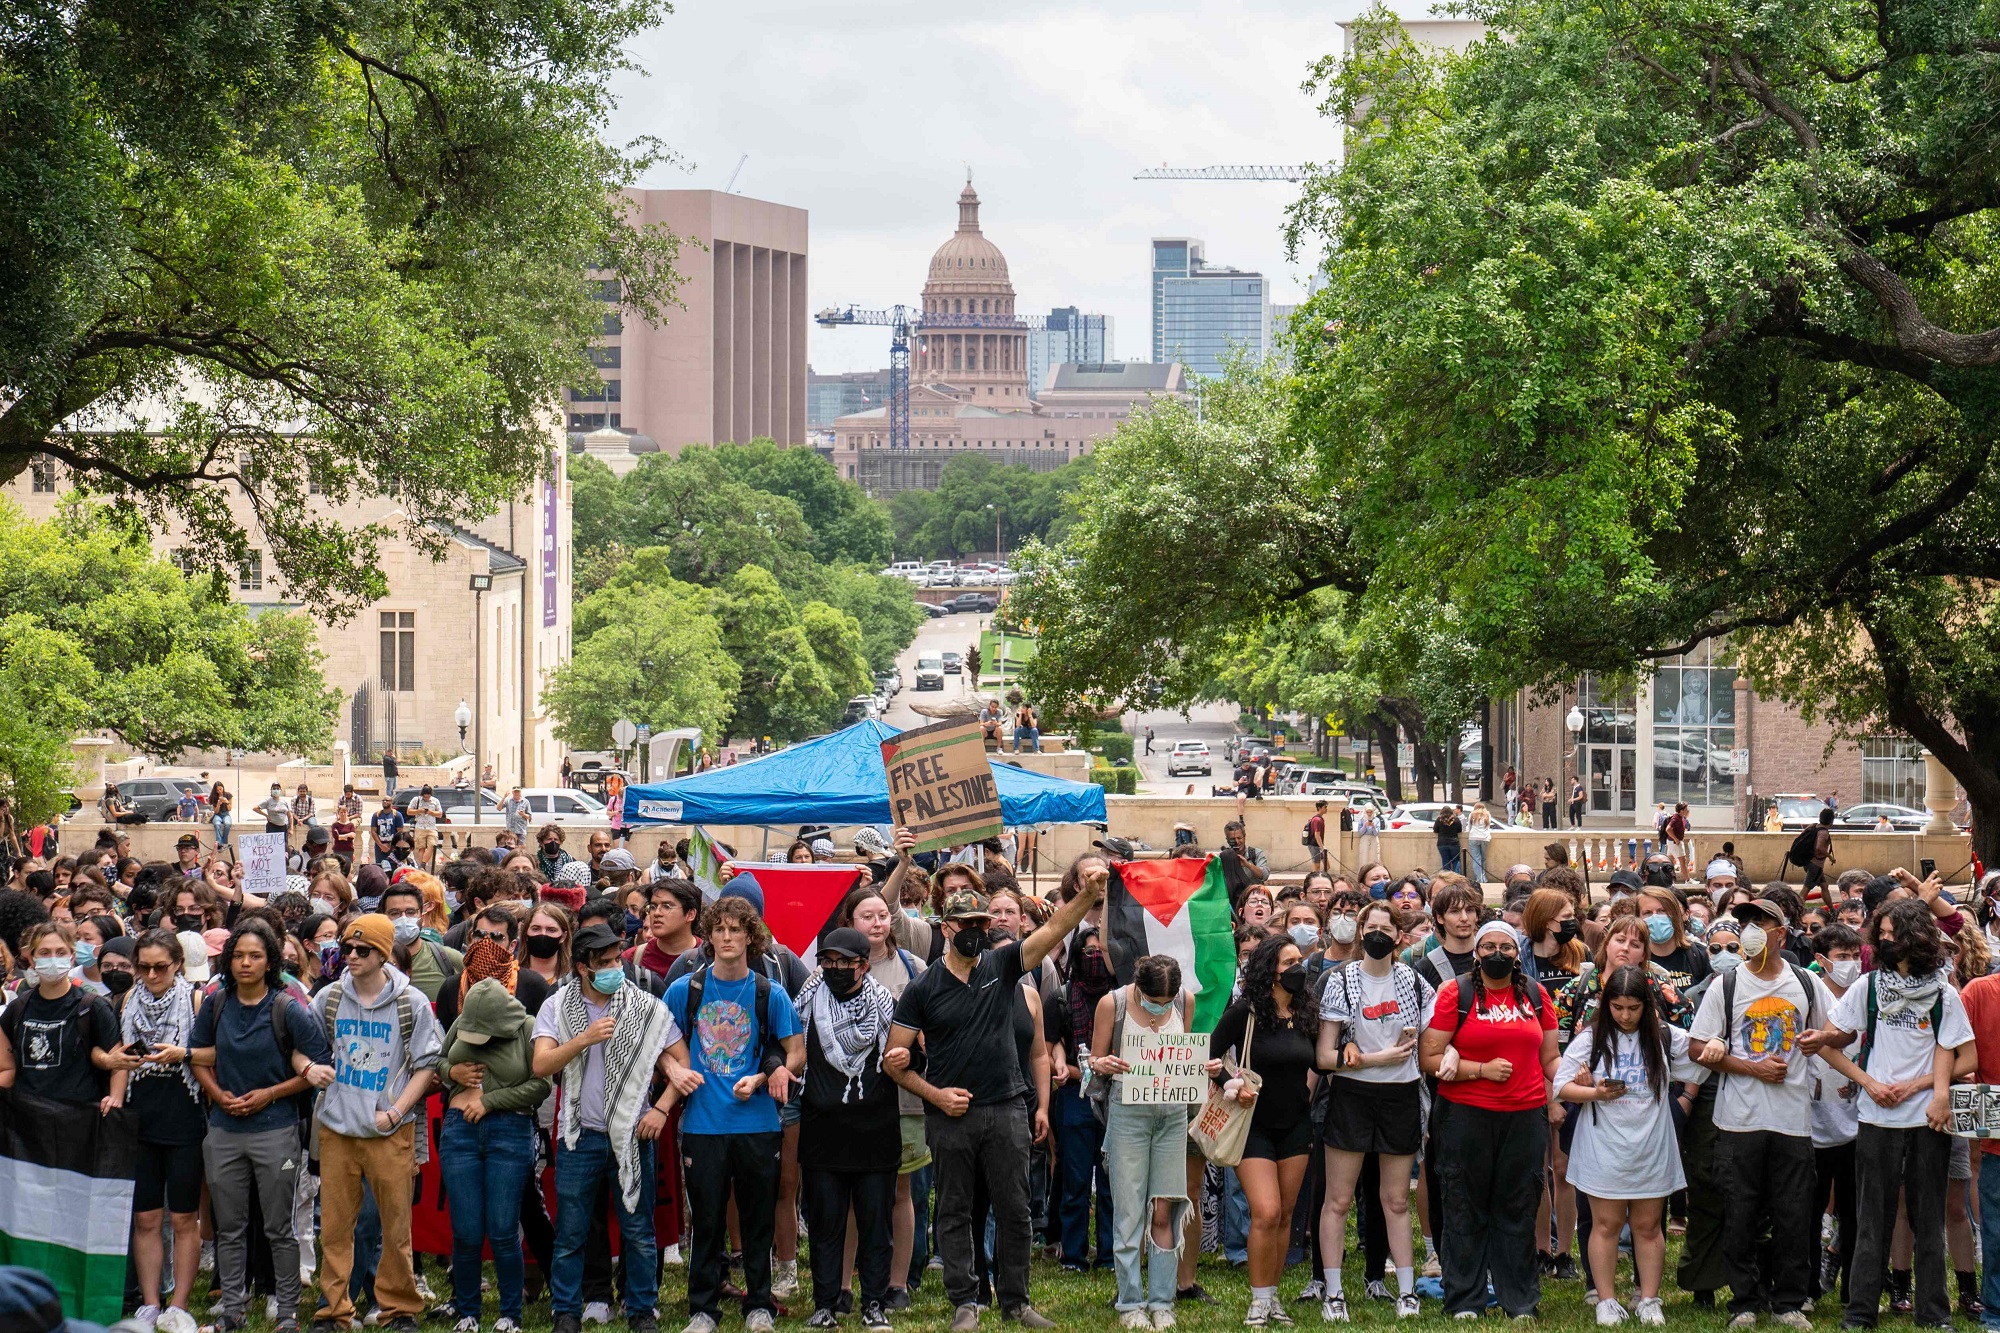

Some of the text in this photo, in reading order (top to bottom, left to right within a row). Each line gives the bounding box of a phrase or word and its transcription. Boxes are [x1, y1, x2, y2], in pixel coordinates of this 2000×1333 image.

[890, 752, 950, 795] FREE
[896, 772, 998, 825] PALESTINE
[651, 806, 680, 814] Academy
[239, 834, 285, 848] BOMBING
[252, 845, 274, 856] KIDS
[251, 858, 271, 870] NOT
[245, 877, 282, 890] DEFENSE
[336, 1019, 392, 1044] DETROIT
[1886, 1019, 1918, 1030] COMMITTEE
[1126, 1034, 1208, 1048] THE STUDENTS
[1616, 1052, 1643, 1068] BU
[336, 1058, 388, 1092] LIONS
[1164, 1064, 1205, 1076] NEVER
[1152, 1076, 1171, 1088] BE
[1132, 1086, 1198, 1102] DEFEATED
